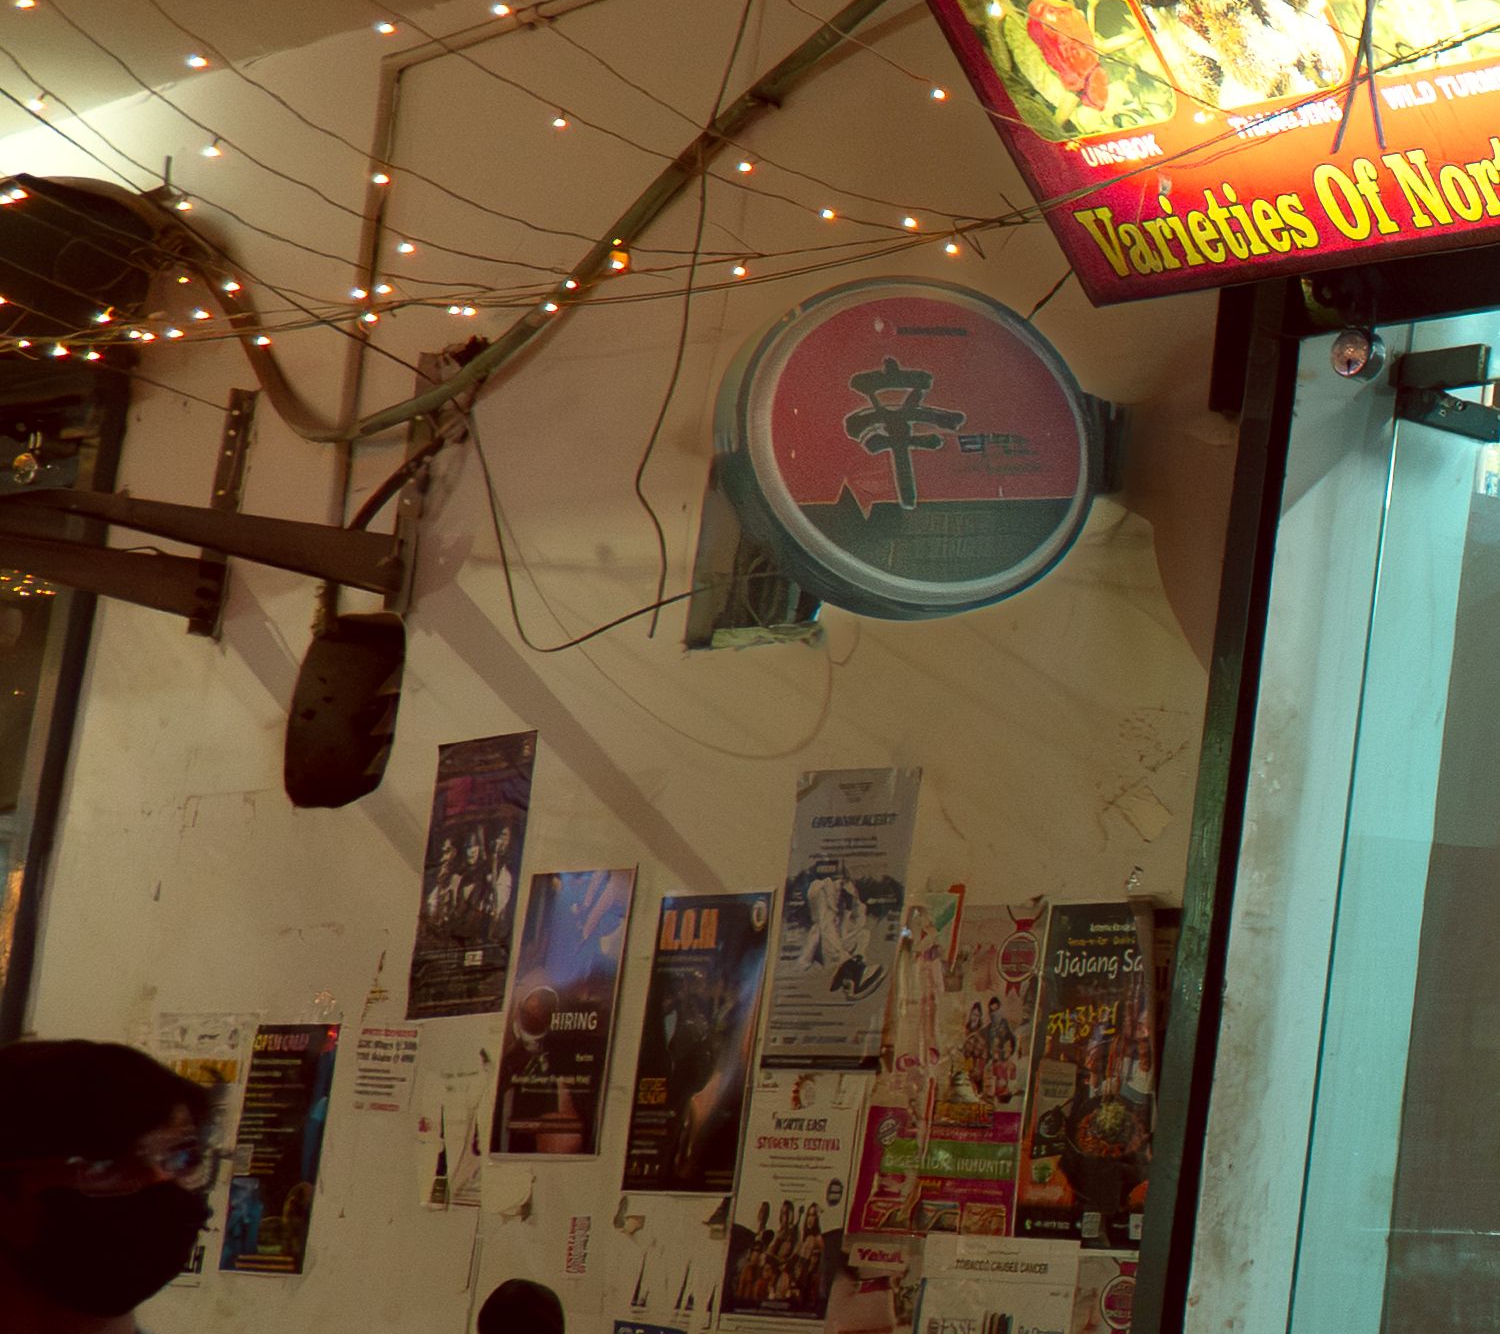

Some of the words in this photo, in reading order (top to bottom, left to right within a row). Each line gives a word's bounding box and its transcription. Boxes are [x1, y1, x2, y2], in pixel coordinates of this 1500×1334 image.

[1072, 181, 1320, 279] Varieties
[1312, 156, 1400, 241] Of
[1053, 949, 1119, 980] Jjajang
[550, 1011, 598, 1031] HIRING
